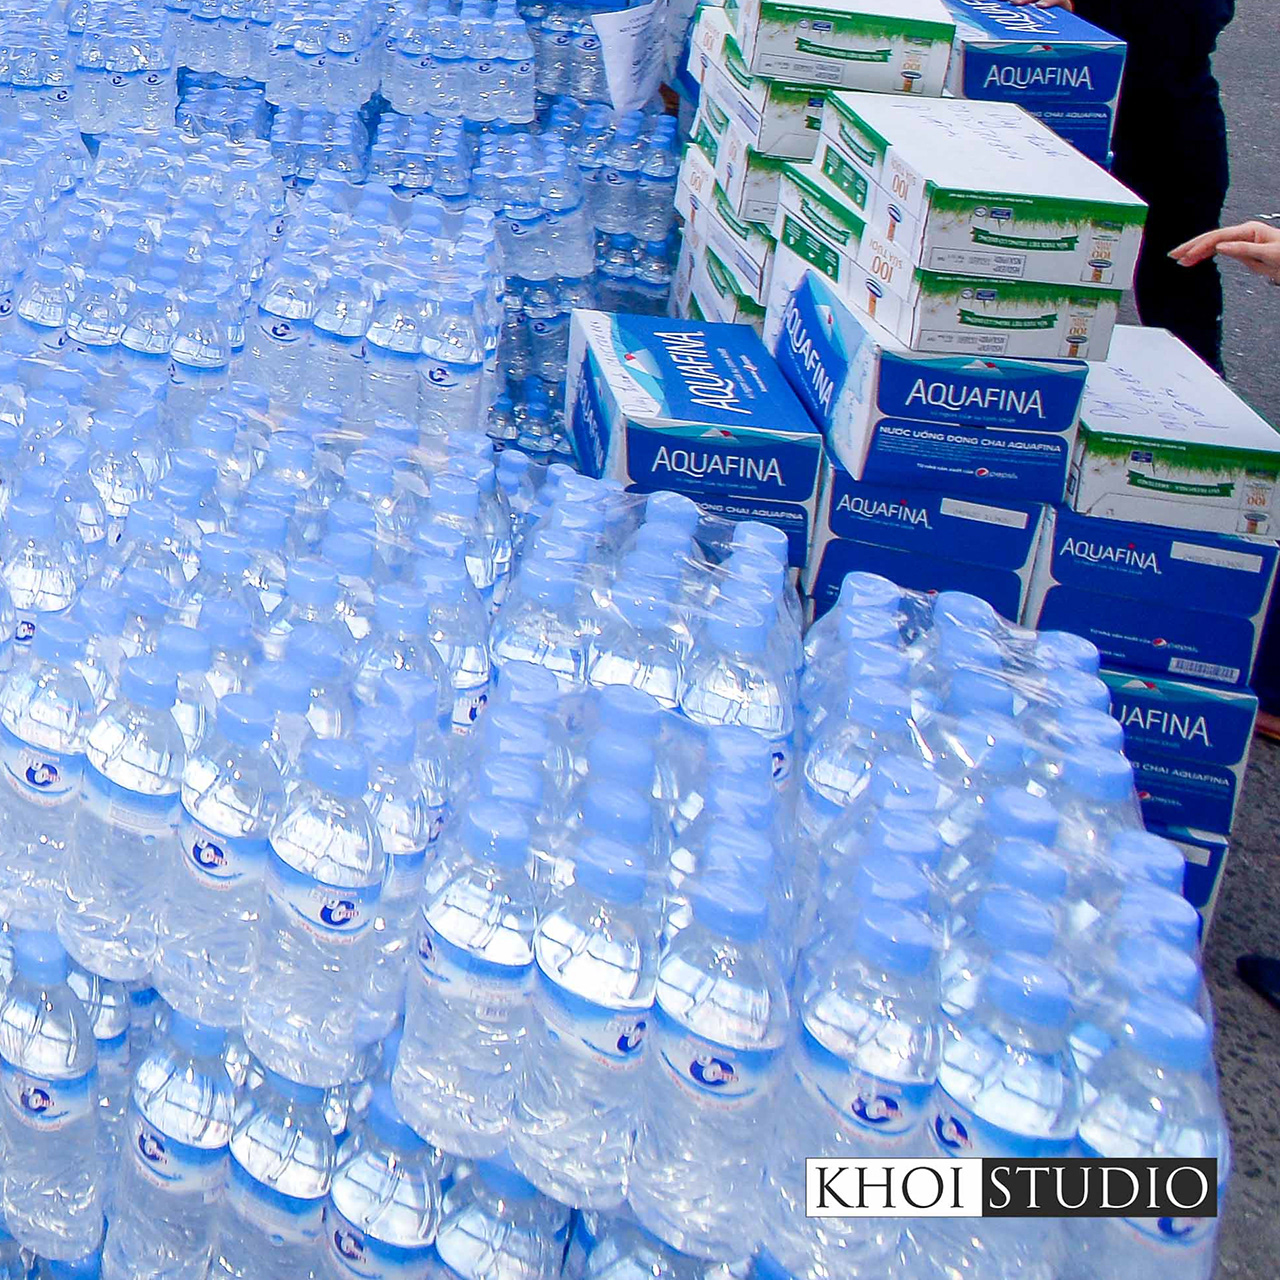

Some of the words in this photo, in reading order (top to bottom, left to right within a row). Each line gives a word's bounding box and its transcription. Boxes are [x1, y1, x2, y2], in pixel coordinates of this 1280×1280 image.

[983, 64, 1095, 91] AQUAFINA
[871, 255, 893, 283] 100
[653, 330, 754, 416] AQUAFINA
[783, 303, 836, 417] AQUAFINA
[904, 377, 1047, 419] AQUAFINA
[878, 425, 912, 438] NƯỚC
[912, 429, 945, 442] UỐNG
[980, 437, 1006, 448] CHAI
[1007, 442, 1062, 453] AQUAFINA
[651, 445, 786, 488] AQUAFINA
[725, 505, 750, 516] CHAI
[751, 508, 804, 521] AQUAFINA
[836, 493, 933, 531] AQUAFINA
[1058, 536, 1163, 576] AQUAFINA
[1117, 708, 1214, 749] UAFINA
[1142, 762, 1171, 774] CHAI
[1171, 767, 1231, 787] AQUAFINA
